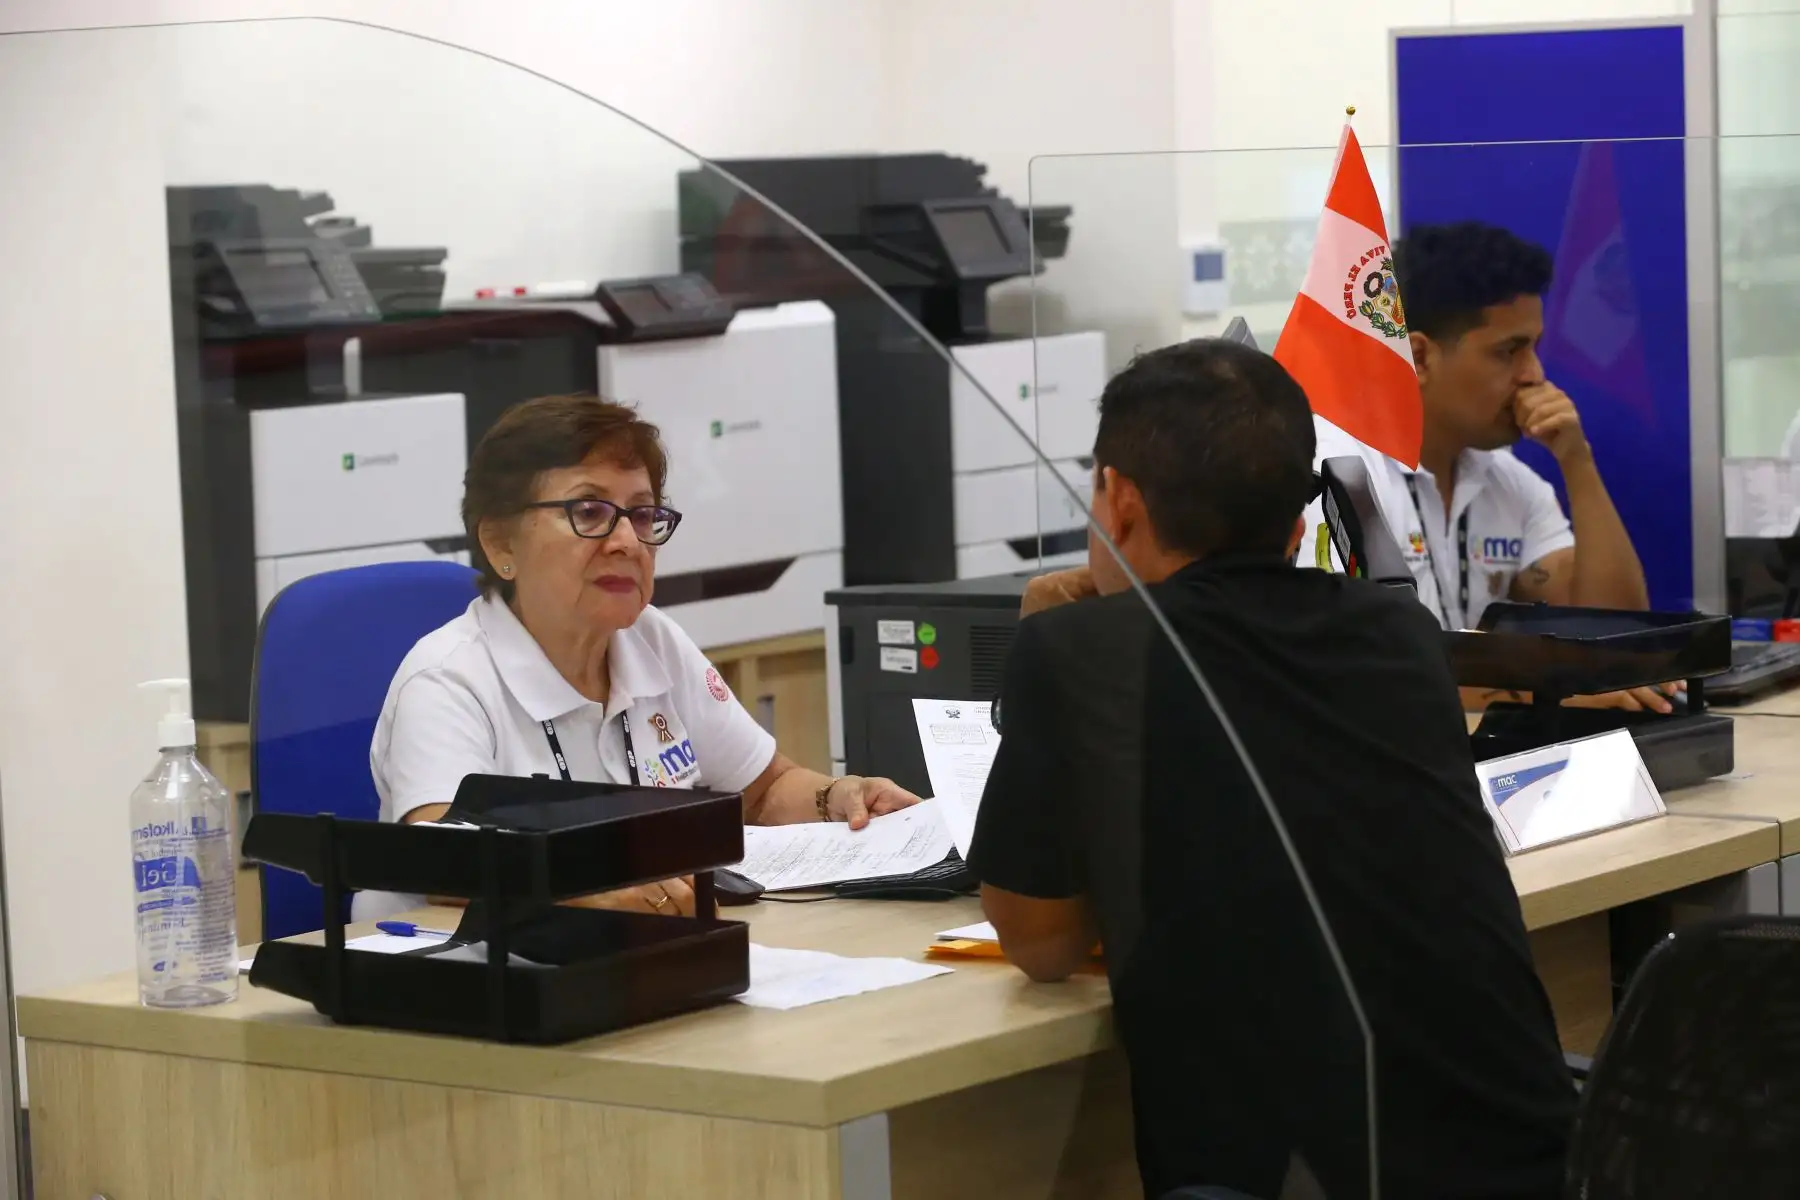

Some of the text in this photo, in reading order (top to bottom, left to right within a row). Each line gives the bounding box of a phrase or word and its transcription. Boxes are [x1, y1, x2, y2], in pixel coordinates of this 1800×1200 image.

[1484, 537, 1523, 557] ma
[659, 739, 696, 775] ma
[1497, 774, 1517, 788] mac
